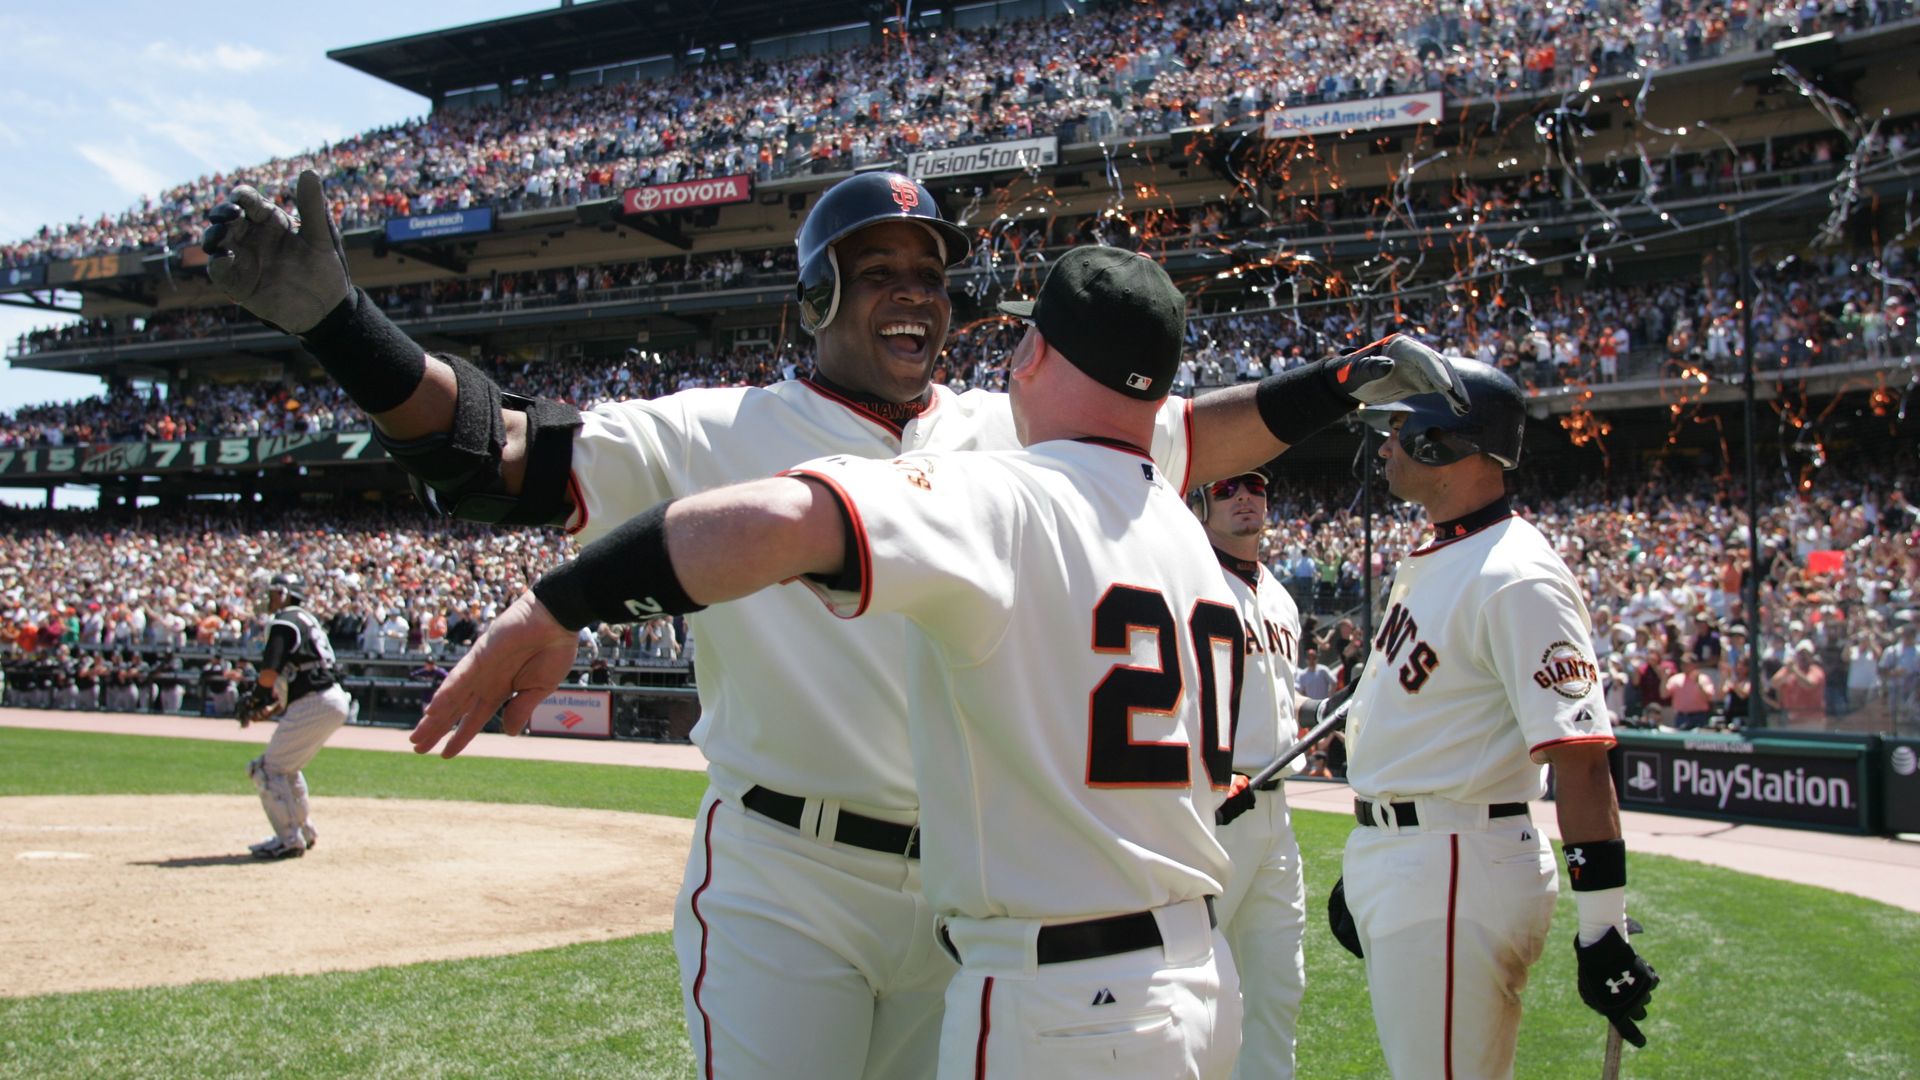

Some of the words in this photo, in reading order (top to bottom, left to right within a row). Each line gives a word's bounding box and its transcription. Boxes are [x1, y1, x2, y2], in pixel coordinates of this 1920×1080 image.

[1332, 106, 1397, 125] America
[913, 147, 1040, 176] FusionStorm
[662, 181, 738, 205] TOYOTA
[72, 254, 119, 282] 715
[151, 439, 250, 468] 715
[624, 597, 668, 619] 2
[1085, 582, 1246, 792] 20
[1533, 659, 1598, 689] GIANTS
[1673, 758, 1850, 809] PlayStation
